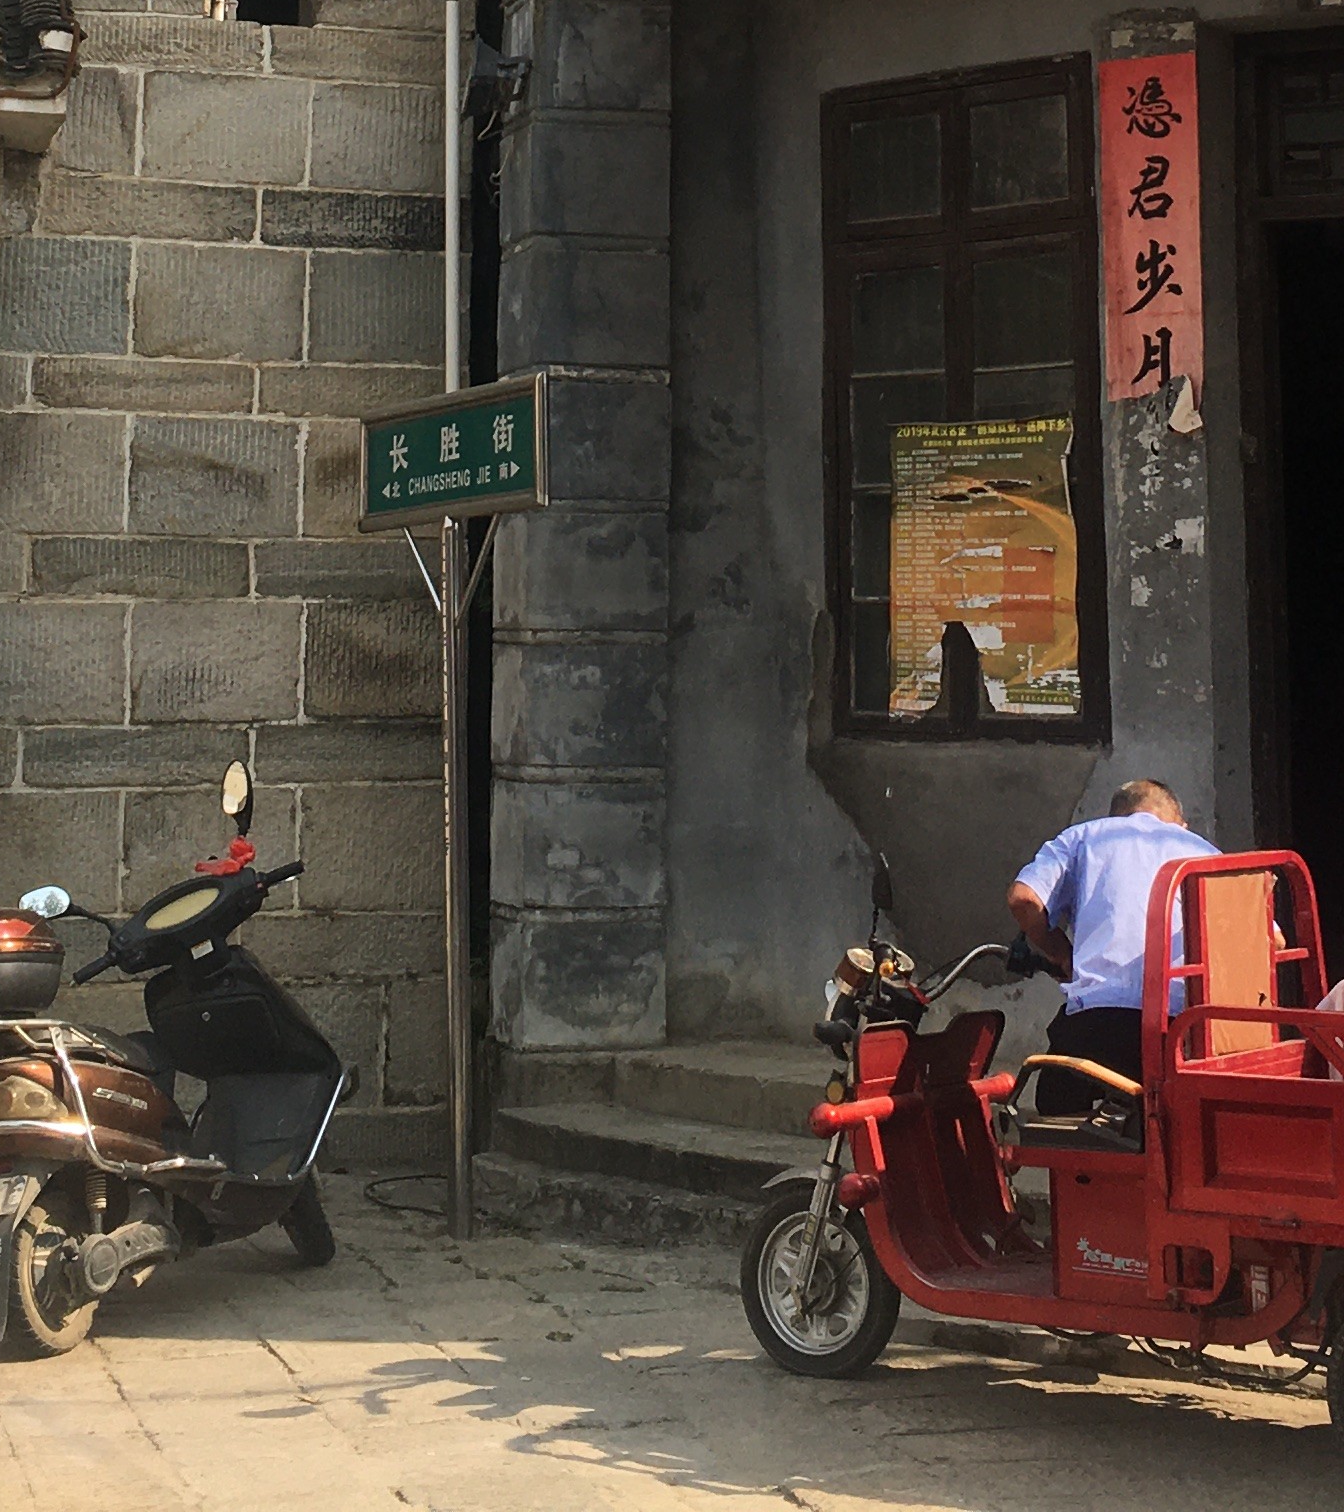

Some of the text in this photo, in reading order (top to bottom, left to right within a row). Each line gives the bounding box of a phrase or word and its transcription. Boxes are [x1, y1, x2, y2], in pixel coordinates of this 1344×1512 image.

[389, 414, 514, 474] 长胜街
[408, 464, 491, 496] CHANGSHENG JIE
[498, 462, 509, 481] 南
